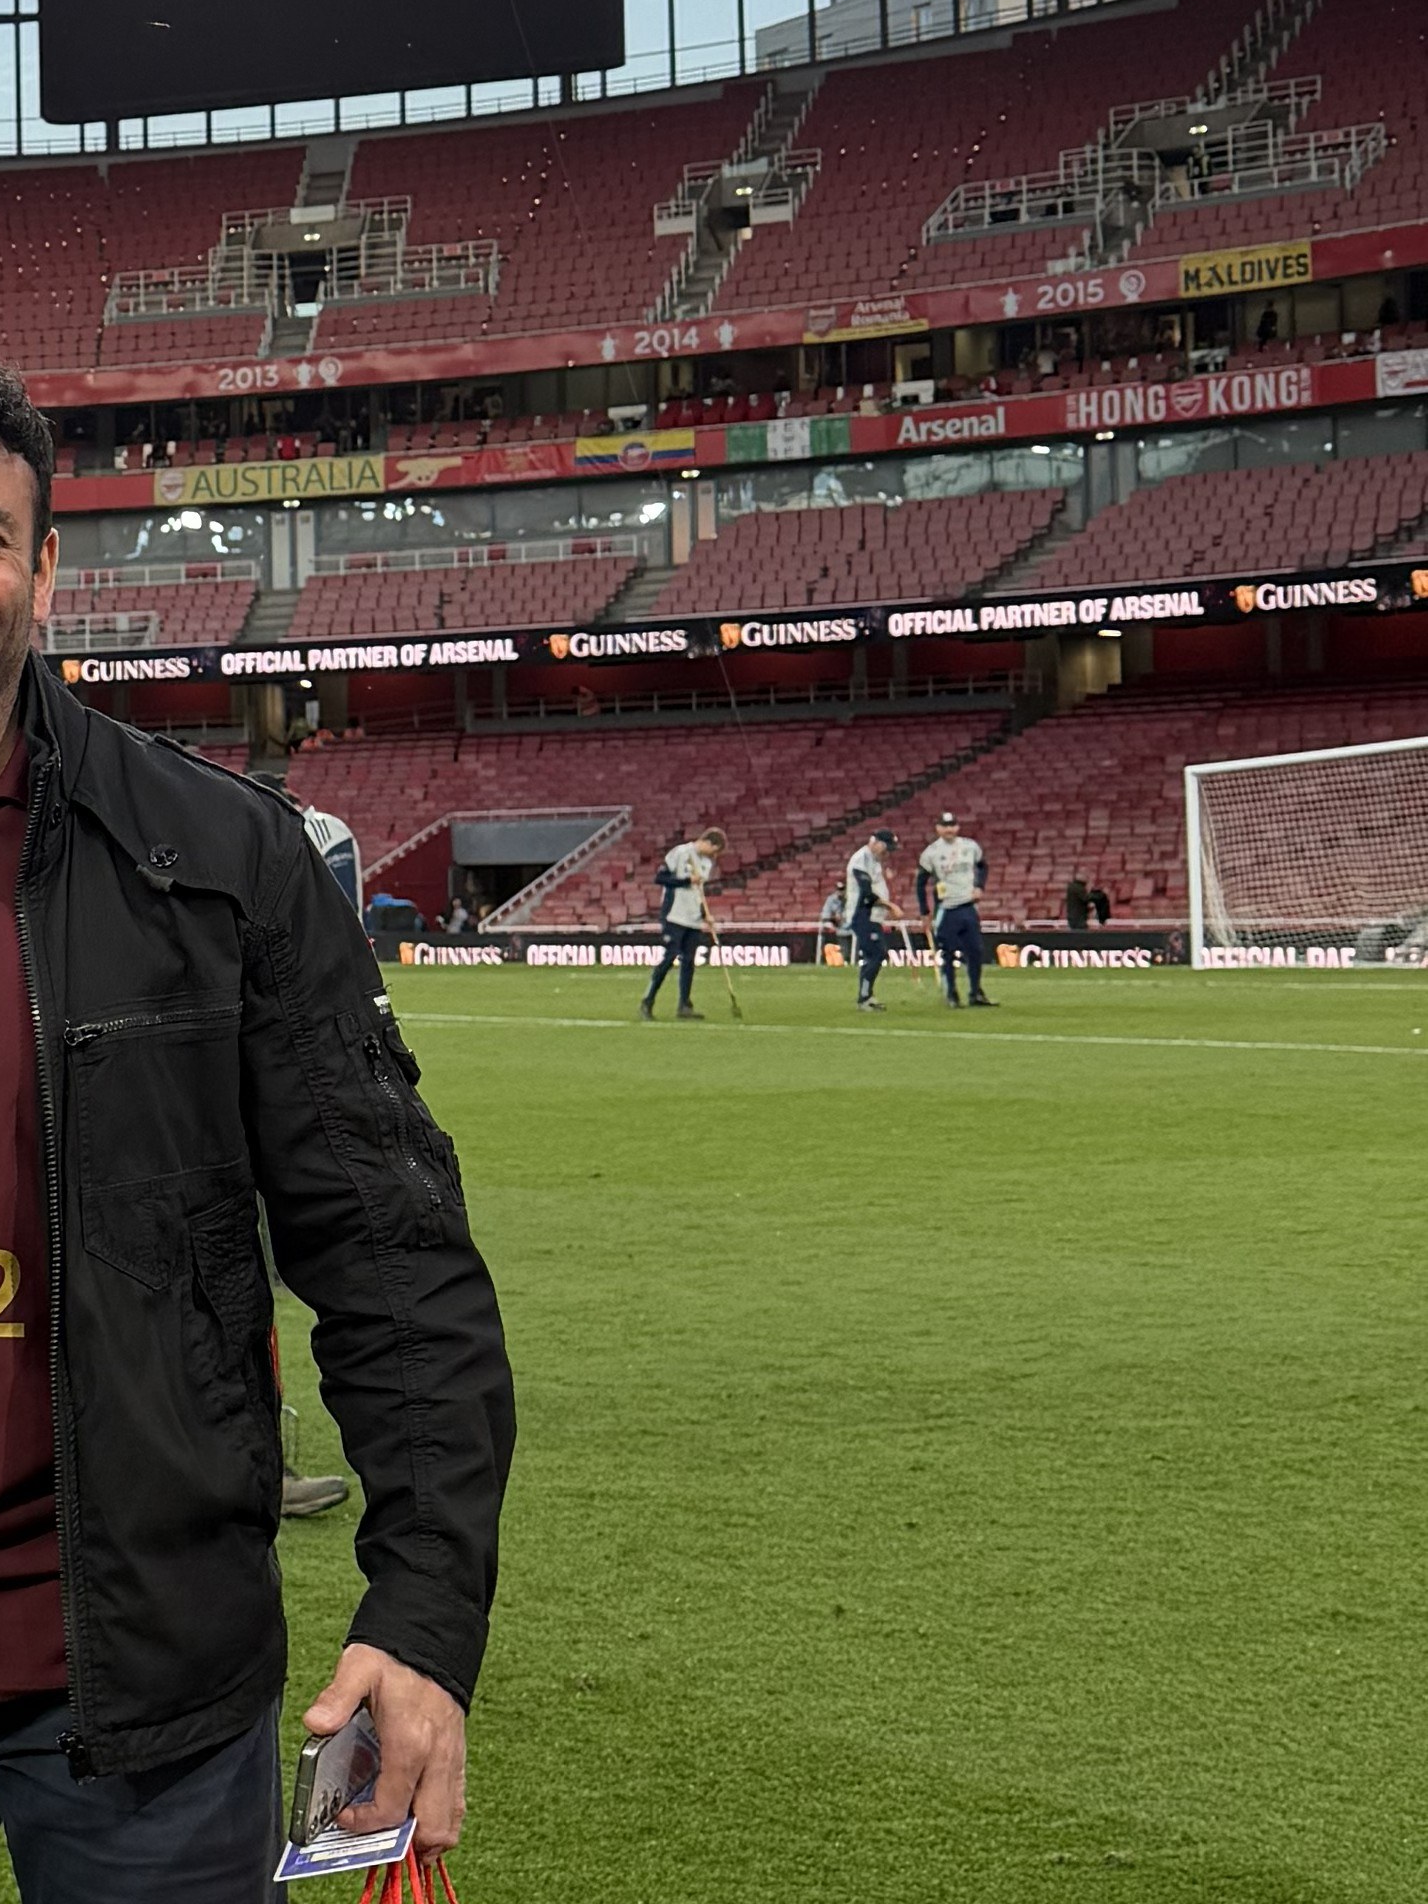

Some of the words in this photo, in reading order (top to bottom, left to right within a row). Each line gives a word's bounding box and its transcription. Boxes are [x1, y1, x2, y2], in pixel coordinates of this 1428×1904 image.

[1183, 252, 1310, 292] MALDIVES
[1035, 278, 1105, 311] 2015
[217, 365, 280, 391] 2013
[1079, 384, 1166, 428] HONG
[1207, 370, 1299, 415] KONG
[897, 406, 1006, 445] Arsenal
[190, 457, 382, 500] AUSTRALIA
[1254, 578, 1378, 611] GUINNESS
[888, 608, 978, 637] OFFICIAL
[980, 602, 1077, 630] PARTNER
[1078, 598, 1108, 624] OF
[1110, 592, 1205, 621] ARSENAL
[569, 629, 688, 658] GUINNESS
[741, 618, 857, 647] GUINNESS
[80, 657, 191, 683] GUINNESS
[221, 651, 306, 676] OFFICIAL
[308, 645, 398, 672] PARTNER
[400, 643, 427, 667] OF
[429, 638, 520, 665] ARSENAL
